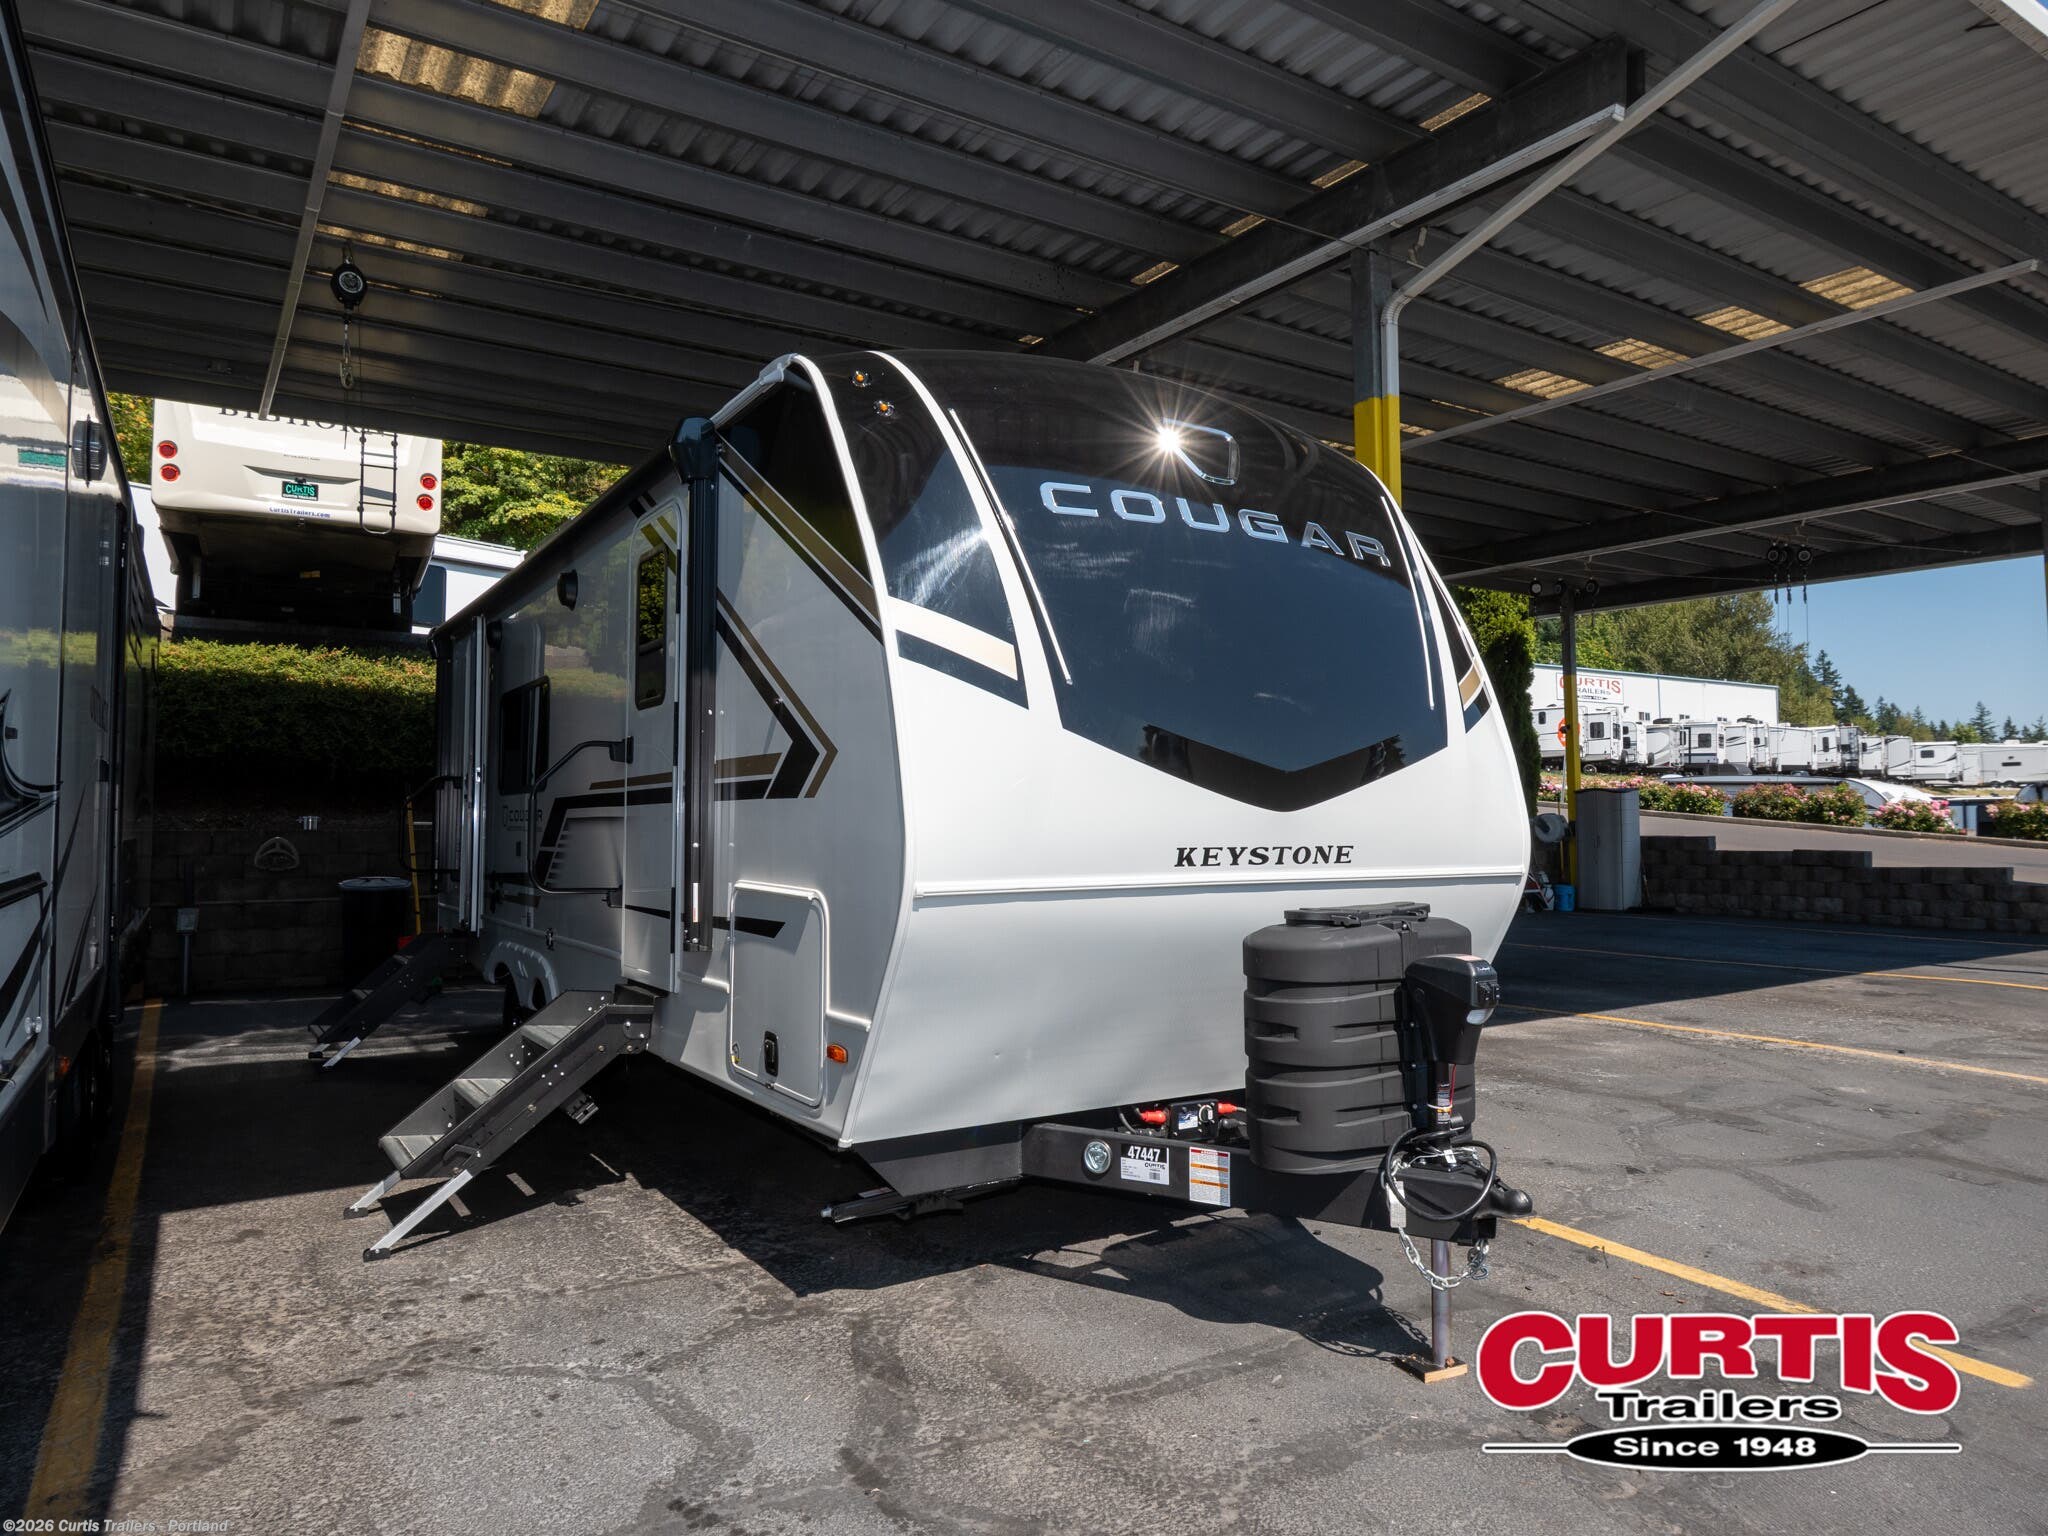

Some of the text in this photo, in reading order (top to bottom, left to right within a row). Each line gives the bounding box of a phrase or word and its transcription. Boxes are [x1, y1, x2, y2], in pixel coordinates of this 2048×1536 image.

[1039, 481, 1391, 568] COUGAR
[1174, 845, 1355, 867] KEYSTONE
[1128, 1145, 1161, 1162] 47447
